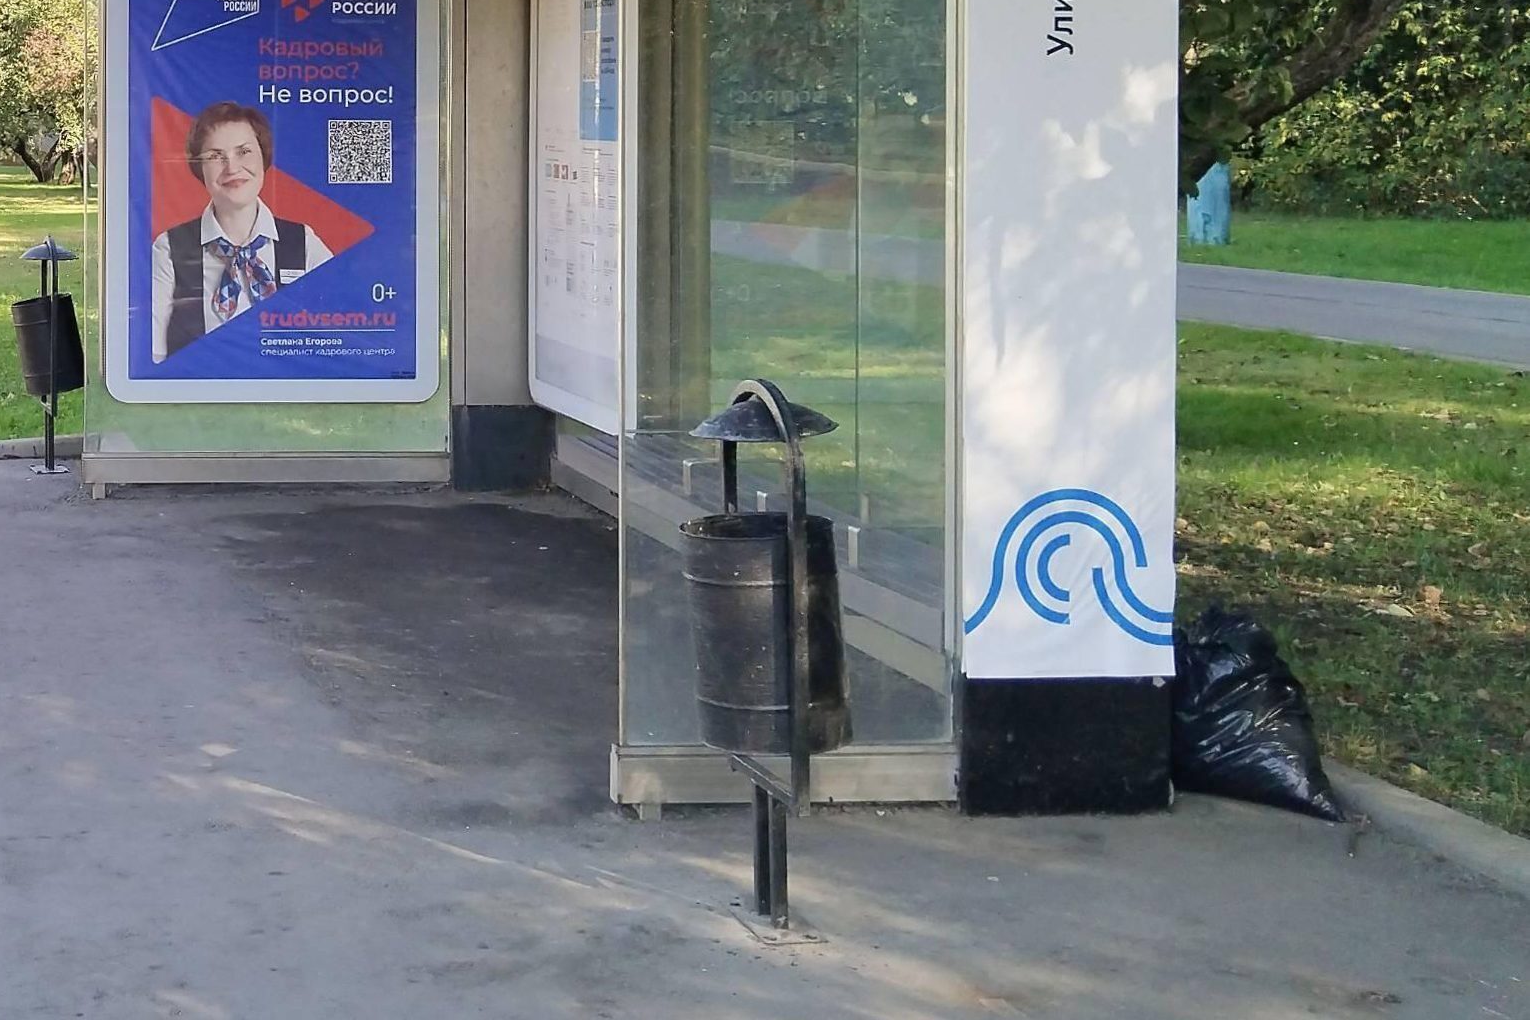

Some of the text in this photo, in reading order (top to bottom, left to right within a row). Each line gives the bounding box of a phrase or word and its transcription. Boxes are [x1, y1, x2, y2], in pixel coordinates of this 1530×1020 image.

[223, 1, 257, 12] РОССИИ
[332, 2, 397, 15] РОССИИ
[258, 38, 384, 59] Кадровый
[258, 61, 360, 83] вопрос?
[258, 84, 394, 108] Не вопрос!
[372, 283, 397, 303] 0+
[259, 309, 397, 327] trudvsem.ru
[260, 337, 343, 347] Светлана Егорова
